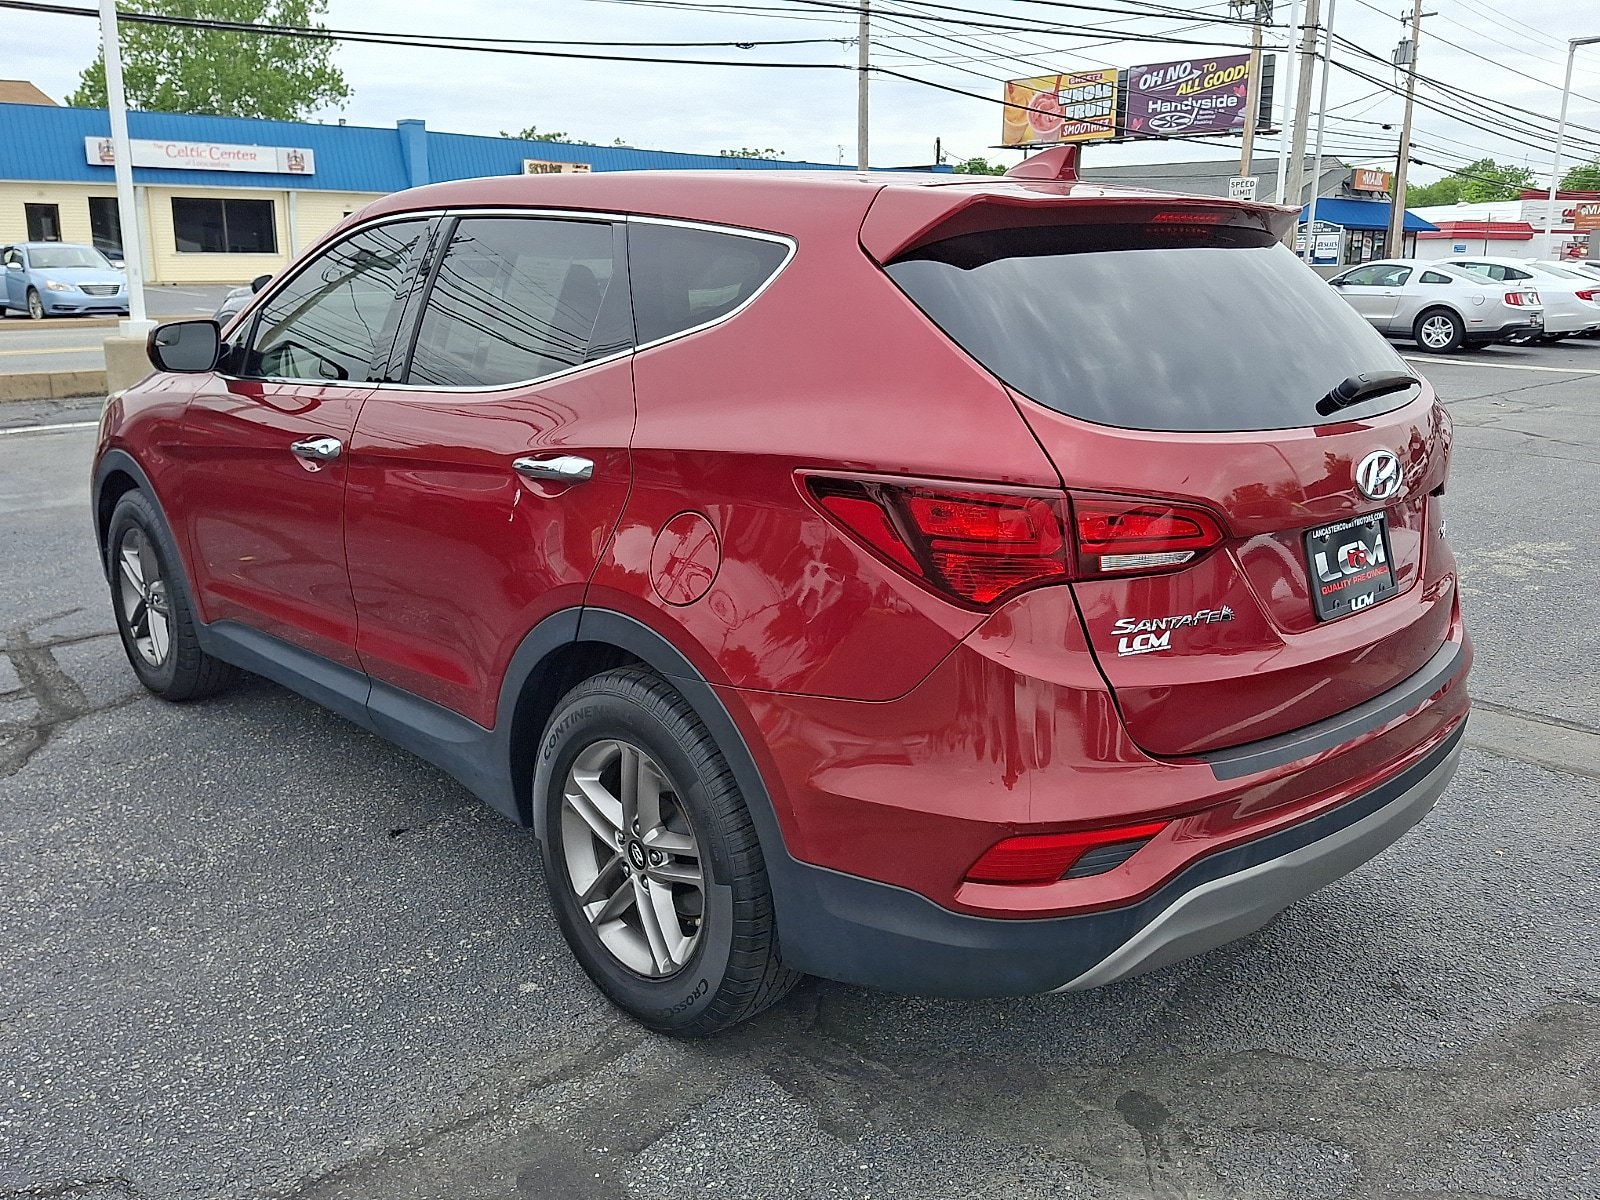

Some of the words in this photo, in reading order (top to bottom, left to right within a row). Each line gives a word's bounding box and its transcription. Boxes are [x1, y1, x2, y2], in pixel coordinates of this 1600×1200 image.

[1139, 70, 1164, 90] OH
[1165, 62, 1192, 82] NO
[1203, 62, 1217, 73] TO
[1176, 79, 1201, 96] ALL
[1203, 61, 1250, 88] GOOD!
[1058, 82, 1113, 105] WHOLE
[1148, 94, 1238, 113] Handyside
[1065, 100, 1112, 121] FRUIT
[165, 144, 207, 159] Celtic
[209, 146, 257, 161] Center
[1230, 180, 1255, 189] SPEED
[1232, 189, 1252, 197] LIMIT
[1314, 533, 1386, 583] LCM
[1321, 579, 1351, 595] QUALITY
[1353, 565, 1389, 584] PRE-OWNED
[1351, 592, 1375, 611] LCM
[1118, 631, 1171, 653] LCM
